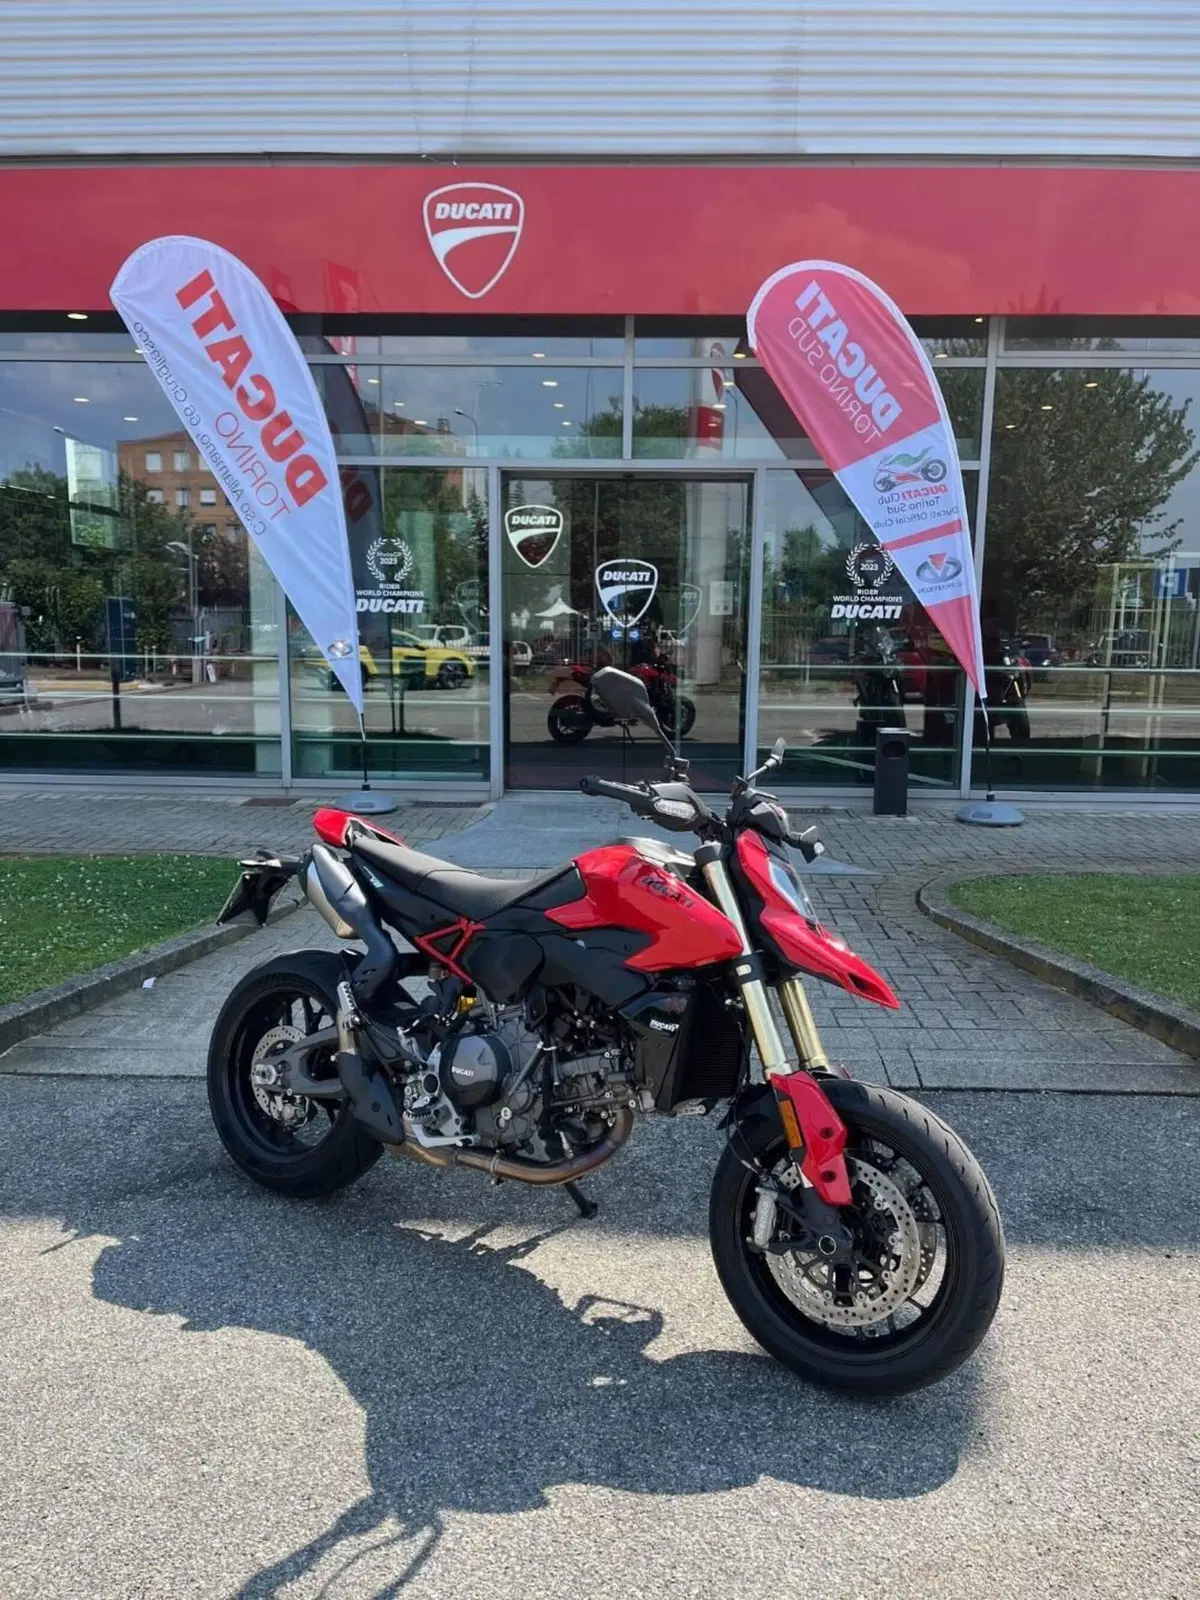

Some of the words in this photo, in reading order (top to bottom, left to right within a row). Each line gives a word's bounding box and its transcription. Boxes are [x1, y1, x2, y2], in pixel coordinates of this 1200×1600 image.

[435, 203, 513, 219] DUCATI
[511, 515, 557, 525] DUCATI
[860, 563, 879, 571] 2023
[603, 571, 650, 582] DUCATI
[356, 599, 424, 613] DUCATI
[831, 604, 902, 619] DUCATI
[452, 1066, 474, 1077] DUCATI
